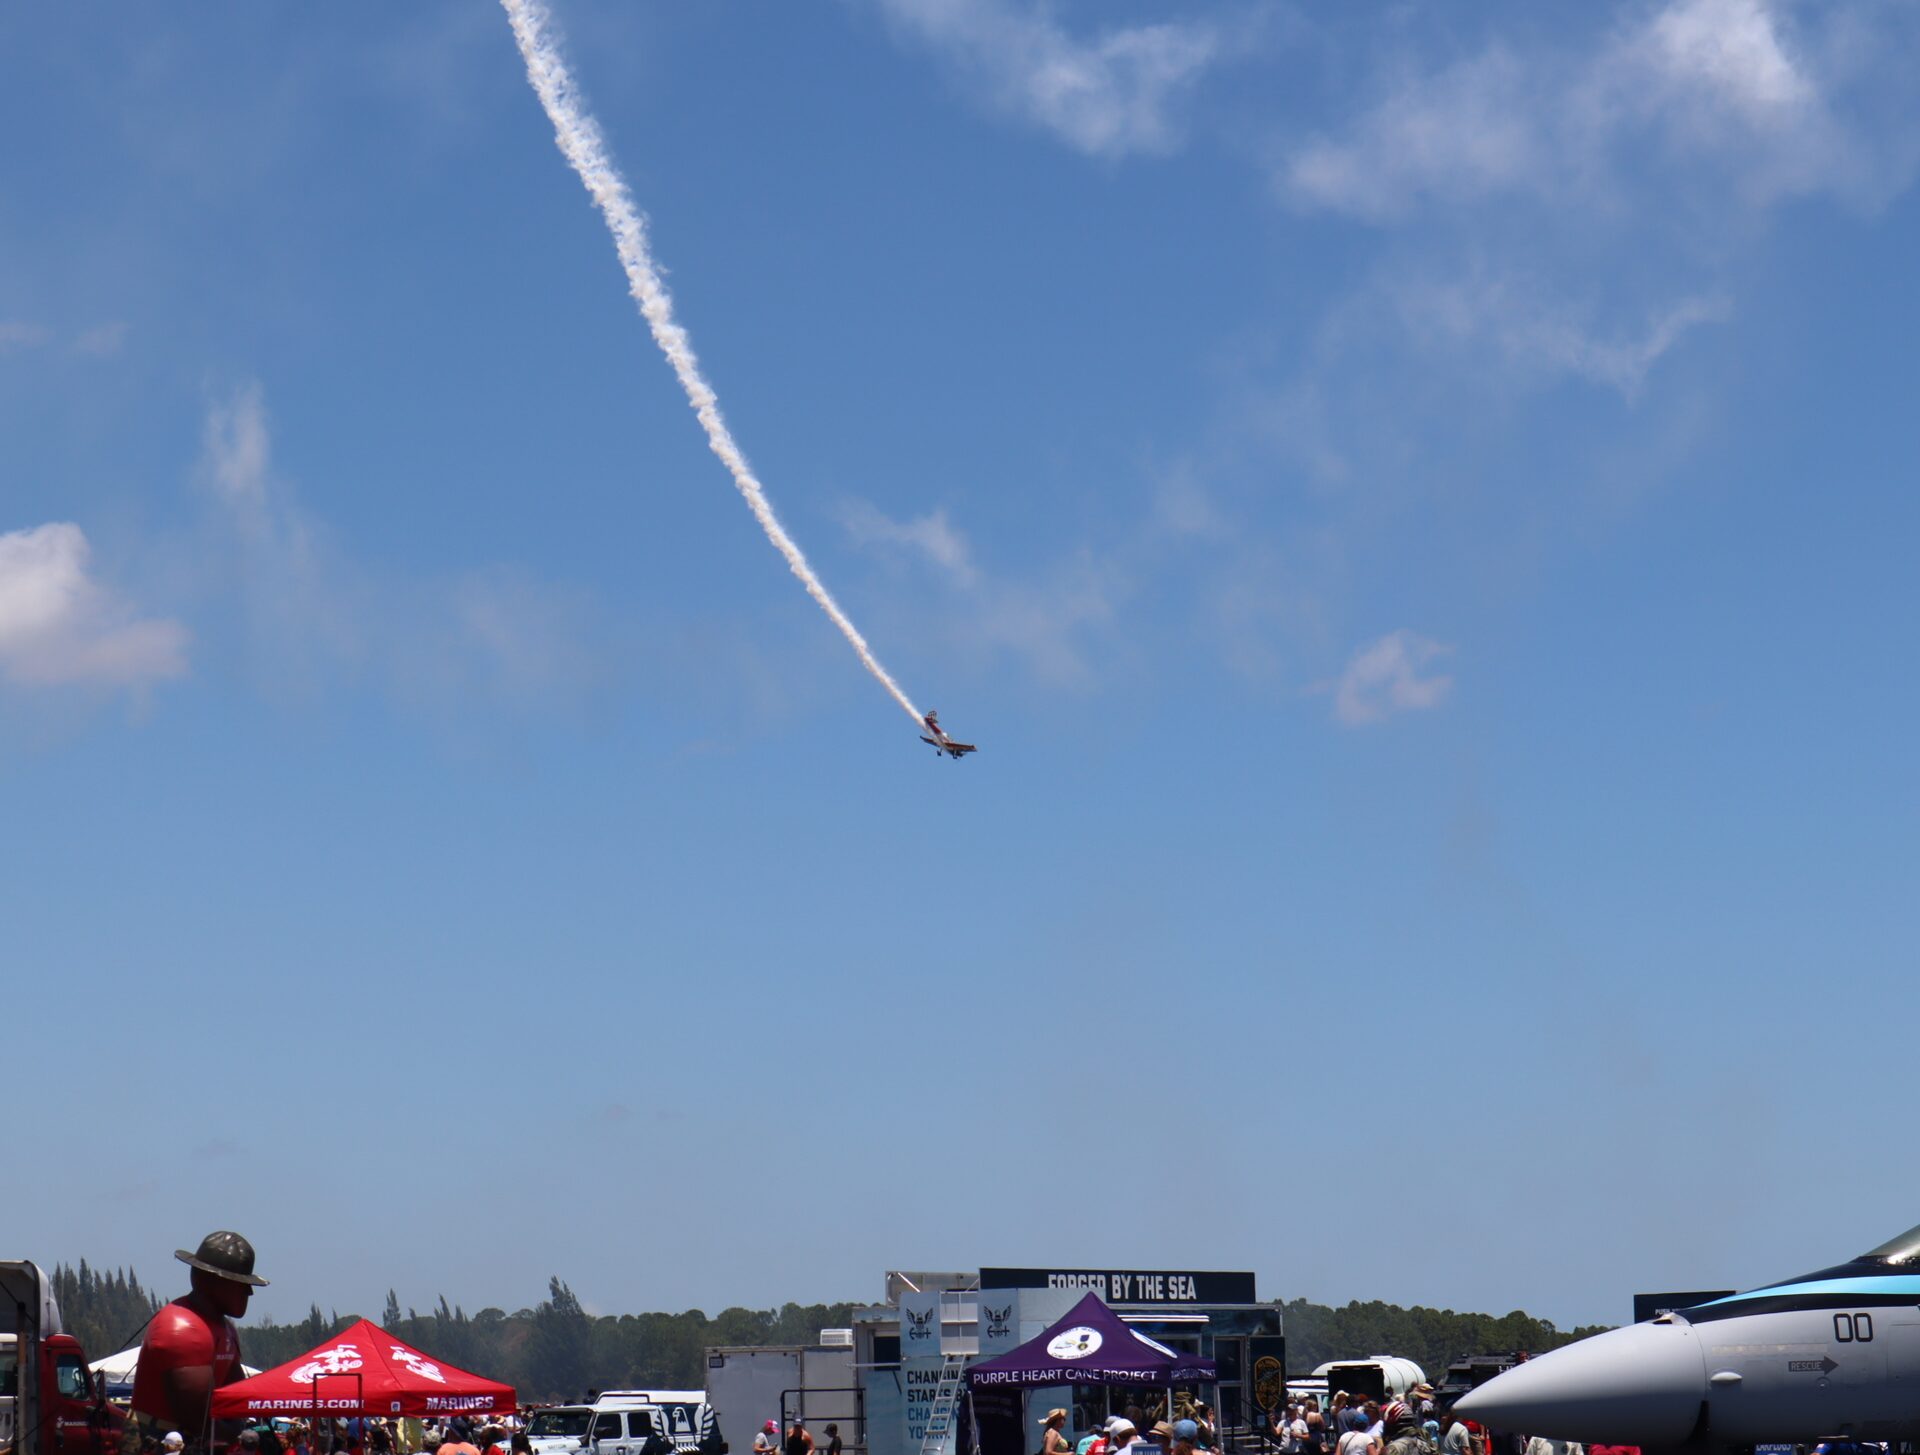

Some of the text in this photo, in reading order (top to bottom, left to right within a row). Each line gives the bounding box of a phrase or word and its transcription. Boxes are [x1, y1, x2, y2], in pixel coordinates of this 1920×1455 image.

[1112, 1274, 1131, 1299] BY
[1136, 1275, 1164, 1299] THE
[1168, 1276, 1197, 1300] SEA
[1790, 1362, 1822, 1371] RESCUE
[973, 1371, 1019, 1384] PURPLE
[1022, 1369, 1063, 1380] HEART
[1065, 1369, 1100, 1380] CANE
[1103, 1370, 1157, 1380] PROJECT
[426, 1396, 494, 1410] MARINES
